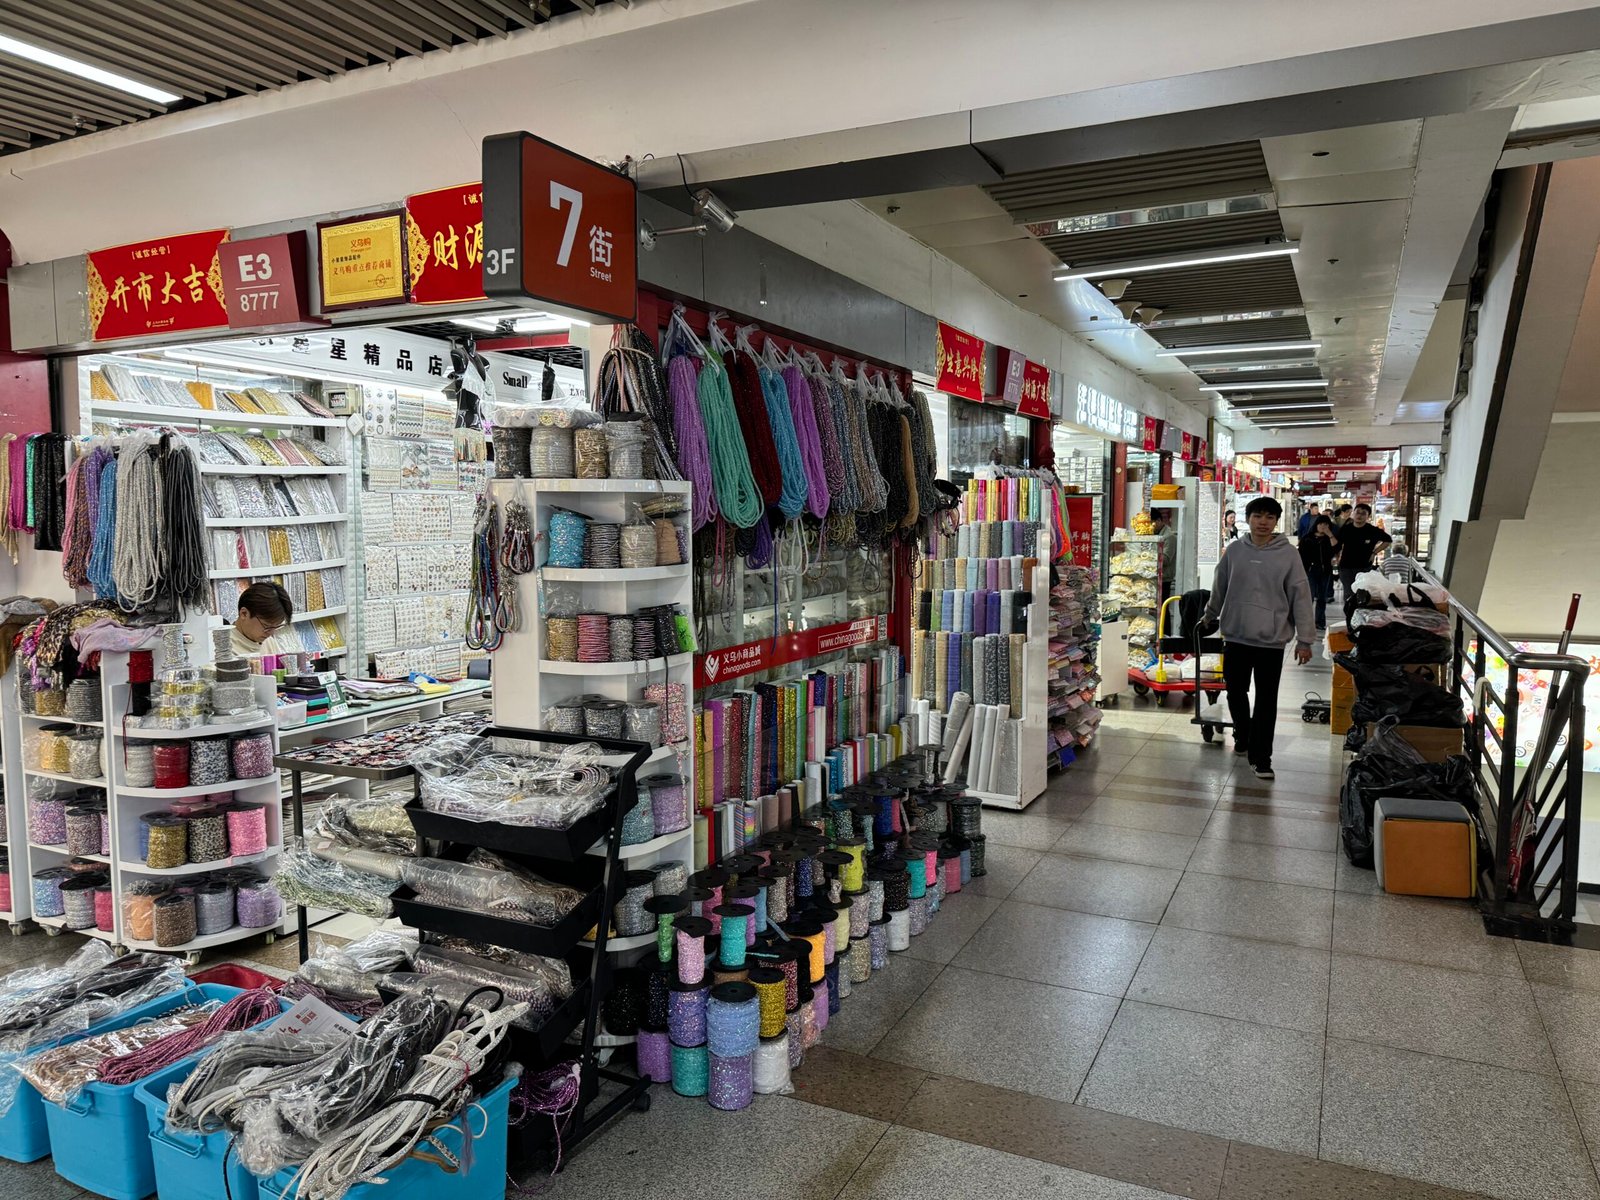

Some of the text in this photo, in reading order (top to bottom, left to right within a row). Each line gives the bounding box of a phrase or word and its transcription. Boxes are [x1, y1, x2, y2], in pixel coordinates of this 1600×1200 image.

[549, 179, 613, 268] 7 街
[350, 237, 372, 248] 义乌购
[238, 253, 273, 282] E3
[486, 248, 516, 276] 3F
[589, 267, 613, 283] Street
[110, 263, 205, 314] 开市大吉
[240, 291, 279, 313] 8777
[1011, 360, 1020, 377] E3
[502, 371, 528, 388] Small
[722, 644, 761, 664] 义乌小商品城
[722, 658, 761, 675] chinagoods.com
